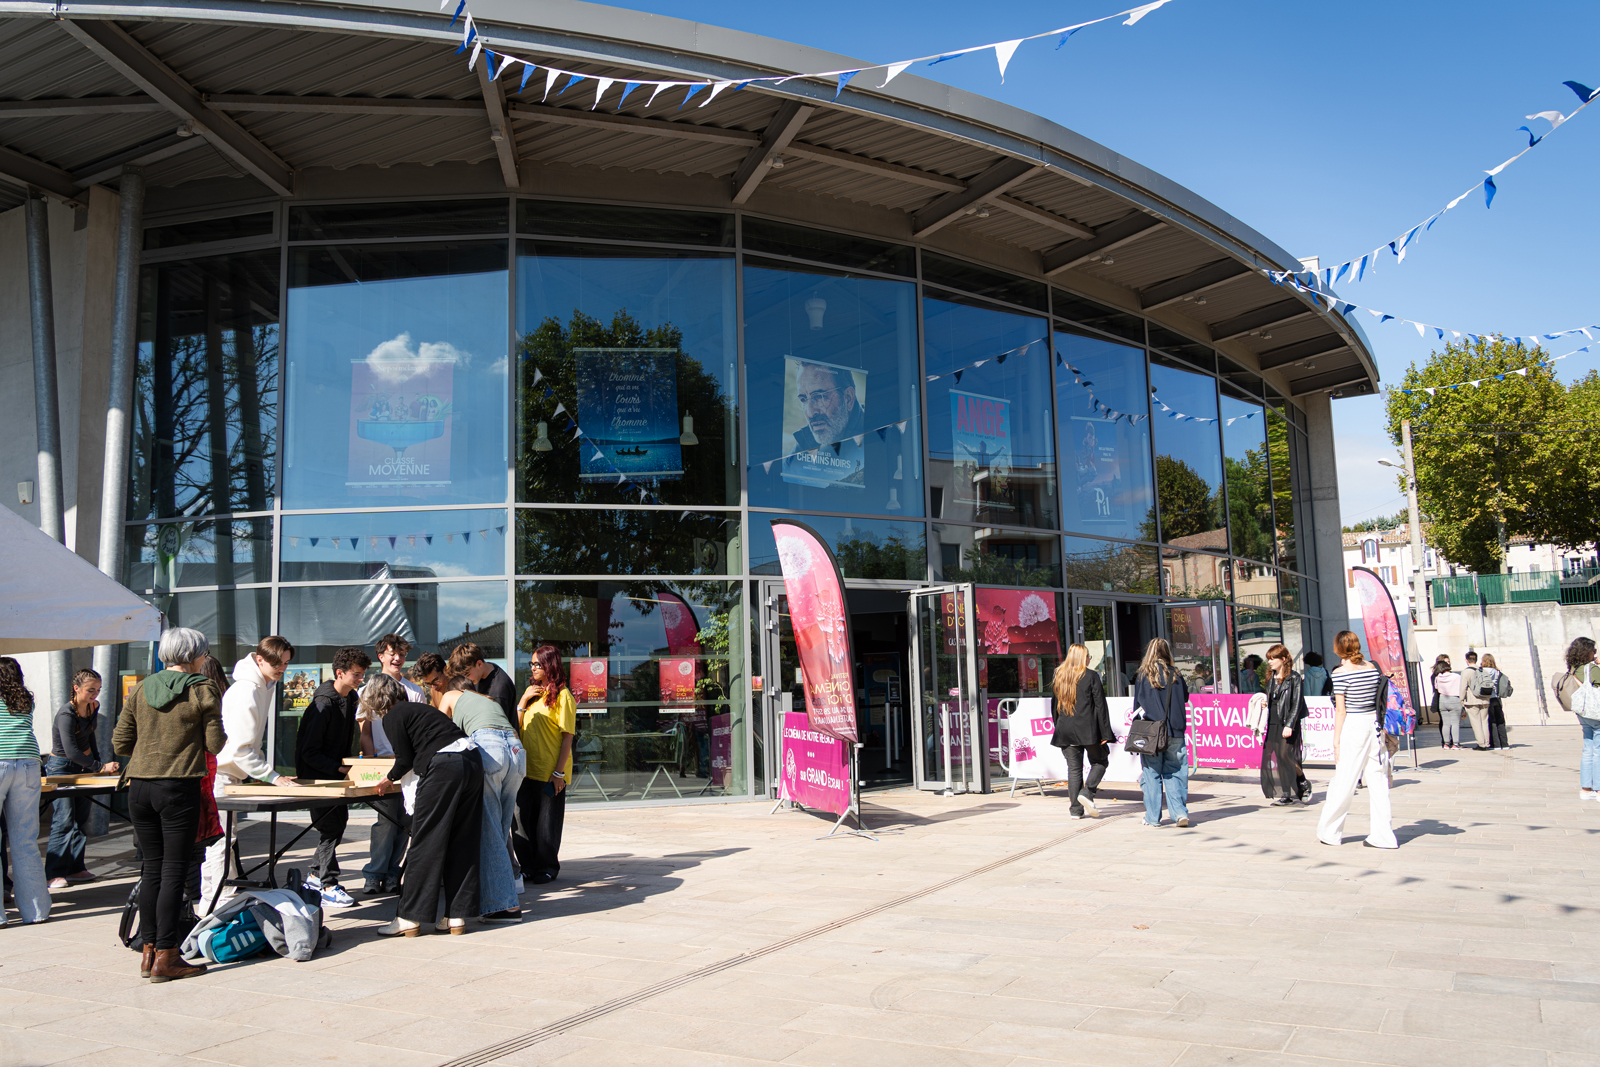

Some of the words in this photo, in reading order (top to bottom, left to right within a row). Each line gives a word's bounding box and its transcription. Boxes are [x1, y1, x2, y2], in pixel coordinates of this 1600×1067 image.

[957, 395, 1007, 438] ANGE
[384, 457, 415, 465] CLASSE
[796, 452, 830, 466] CHEMINS
[830, 456, 852, 469] NOIRS
[368, 464, 430, 476] MOYENNE
[1093, 487, 1111, 516] Pil
[1186, 706, 1247, 727] ESTIVAL
[1307, 706, 1337, 719] ESTI
[783, 727, 788, 738] LE
[801, 729, 807, 741] DE
[1226, 734, 1256, 749] D'ICI
[806, 767, 828, 787] GRAND
